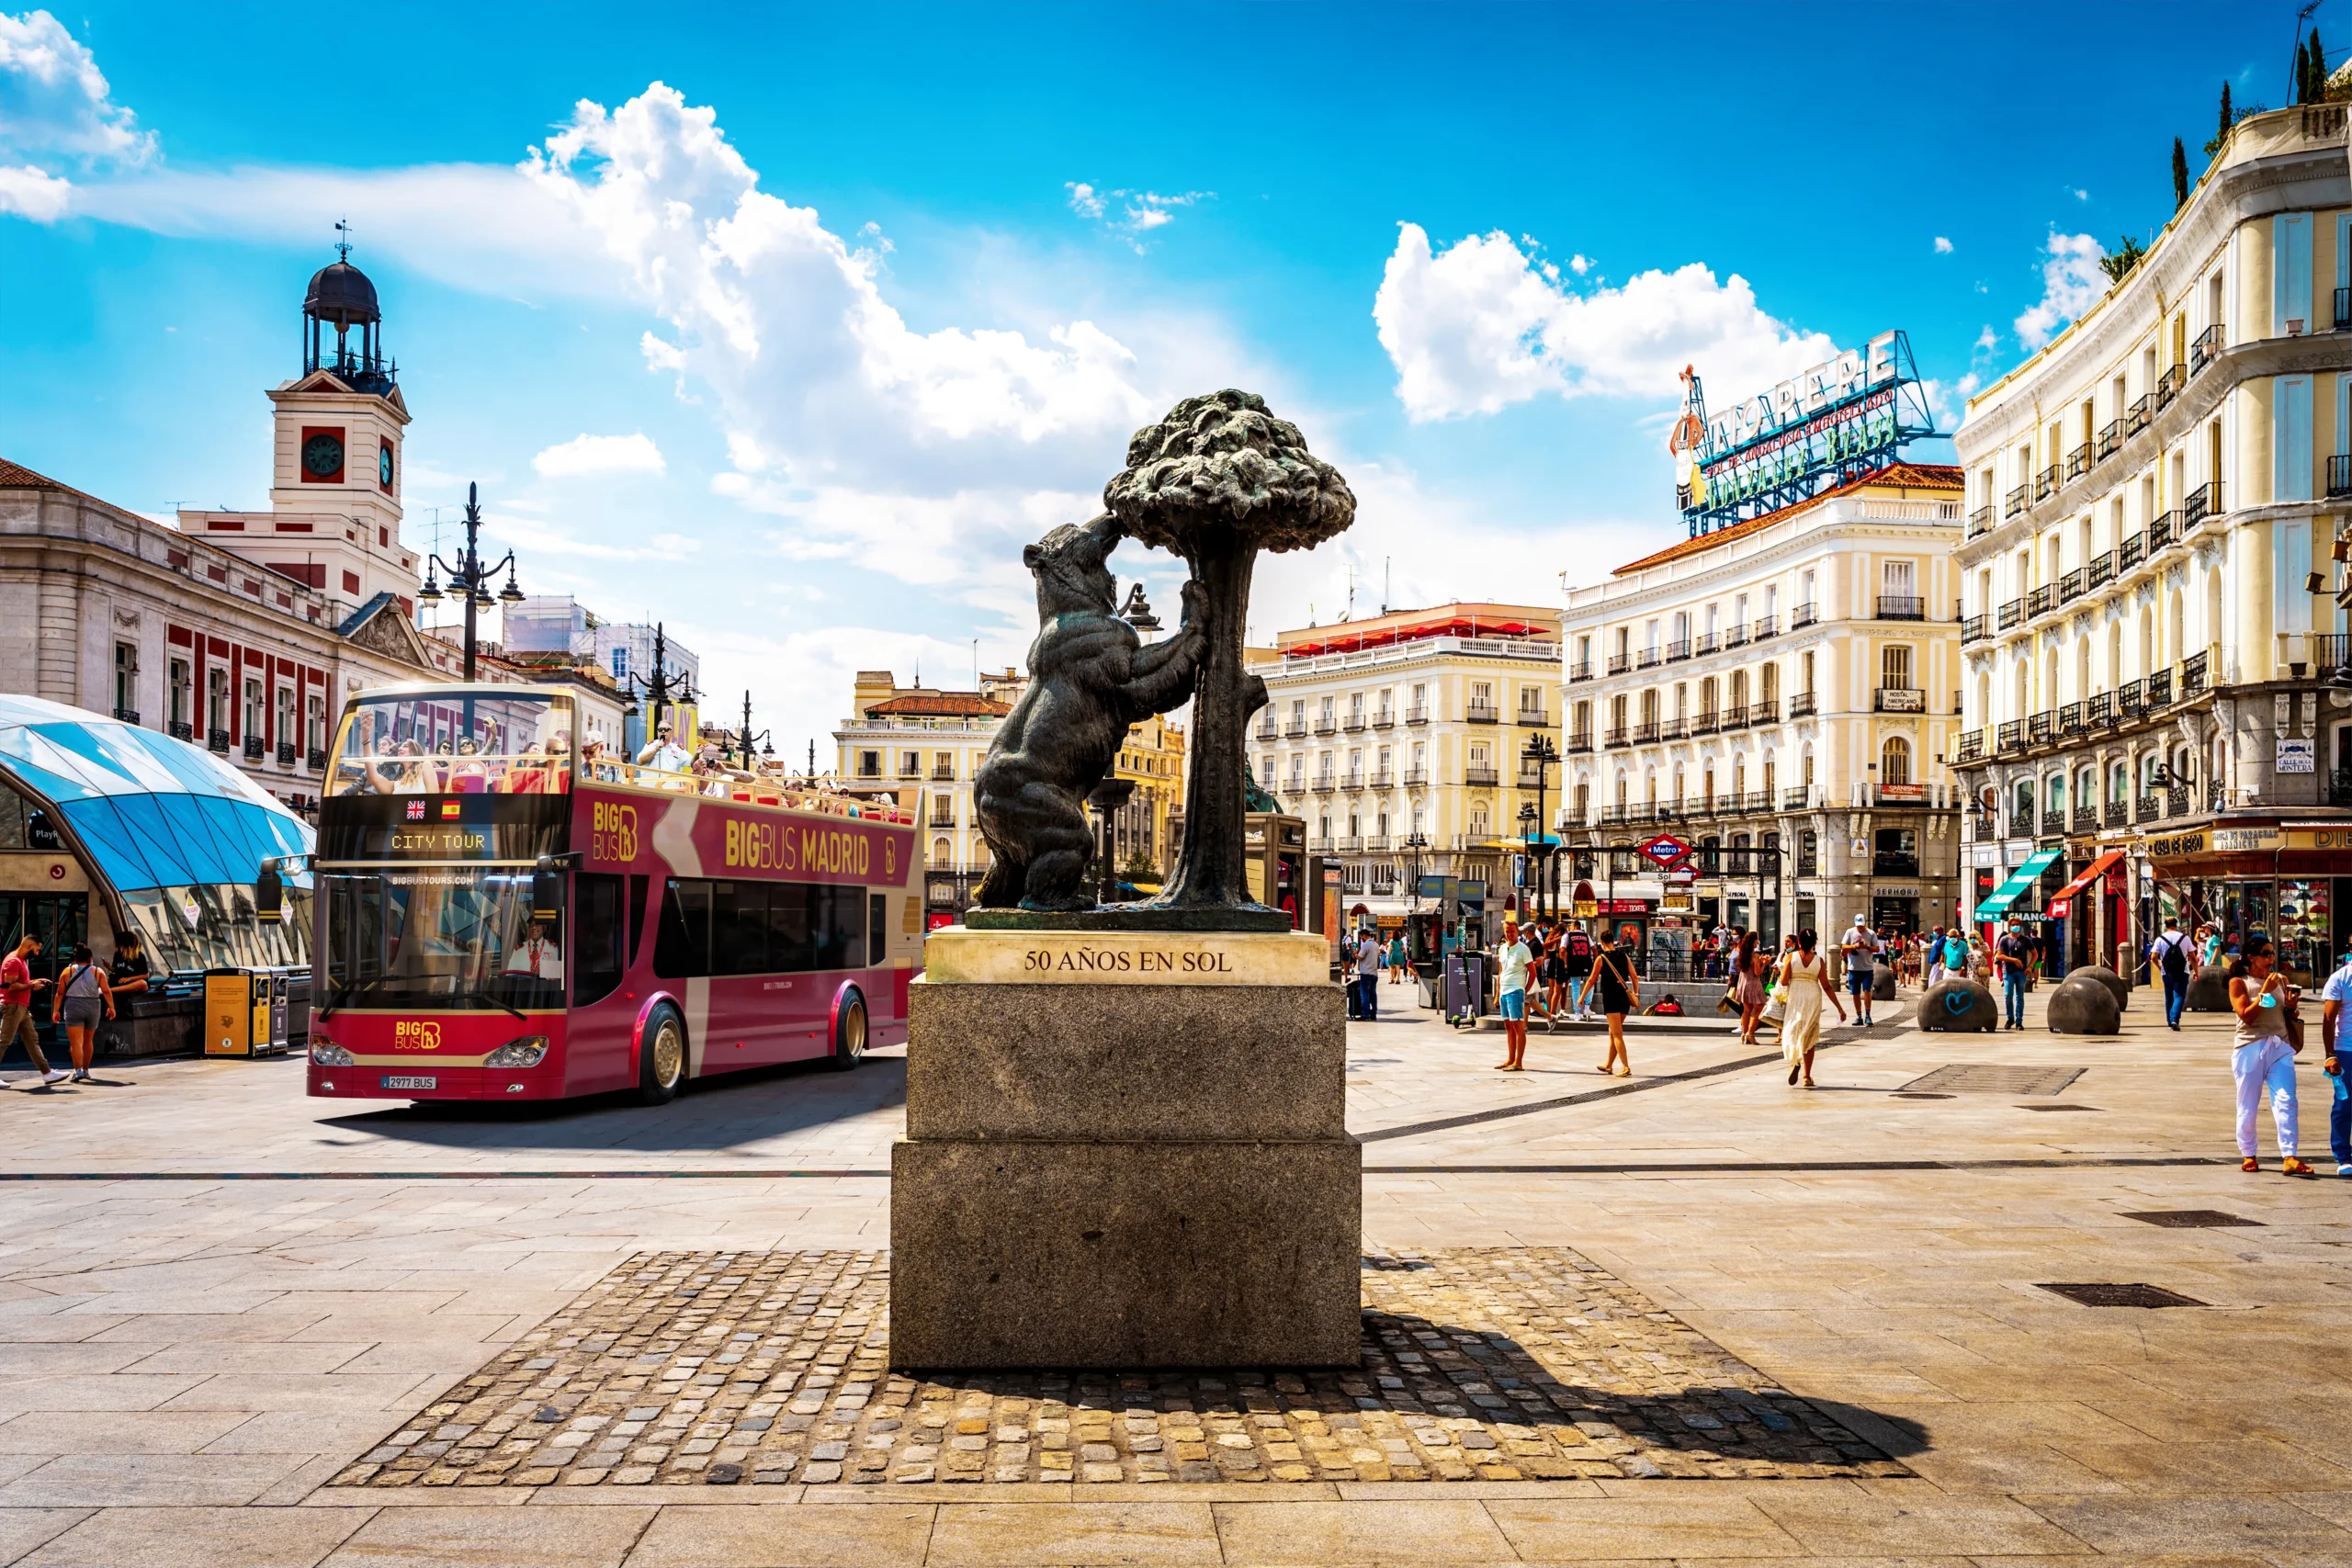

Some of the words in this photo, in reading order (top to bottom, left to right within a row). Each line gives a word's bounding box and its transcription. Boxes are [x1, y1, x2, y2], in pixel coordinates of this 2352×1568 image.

[1708, 397, 1762, 454] TIO
[1774, 330, 1895, 426] PEPE
[1706, 460, 1725, 479] SOL
[1728, 453, 1742, 469] DE
[1804, 389, 1894, 436] EMBOTELLADO
[1826, 412, 1896, 466] BYASS
[594, 801, 619, 832] BIG
[391, 835, 435, 849] CITY
[443, 835, 485, 848] TOUR
[2154, 839, 2170, 855] CASA
[2171, 837, 2181, 854] DE
[2182, 833, 2203, 852] DIEGO
[2221, 839, 2259, 849] ABANICOS
[2239, 829, 2278, 840] PARAGUAS
[593, 833, 618, 861] BUS
[802, 829, 869, 874] MADRID
[392, 876, 474, 886] BIGBUSTOURS.COM
[1024, 951, 1051, 971] 50
[1057, 946, 1130, 971] AÑOS
[1139, 952, 1174, 972] EN
[1182, 952, 1232, 972] SOL
[396, 1021, 421, 1036] BIG
[395, 1036, 421, 1049] BUS
[390, 1077, 411, 1088] 2977
[413, 1077, 433, 1088] BUS
